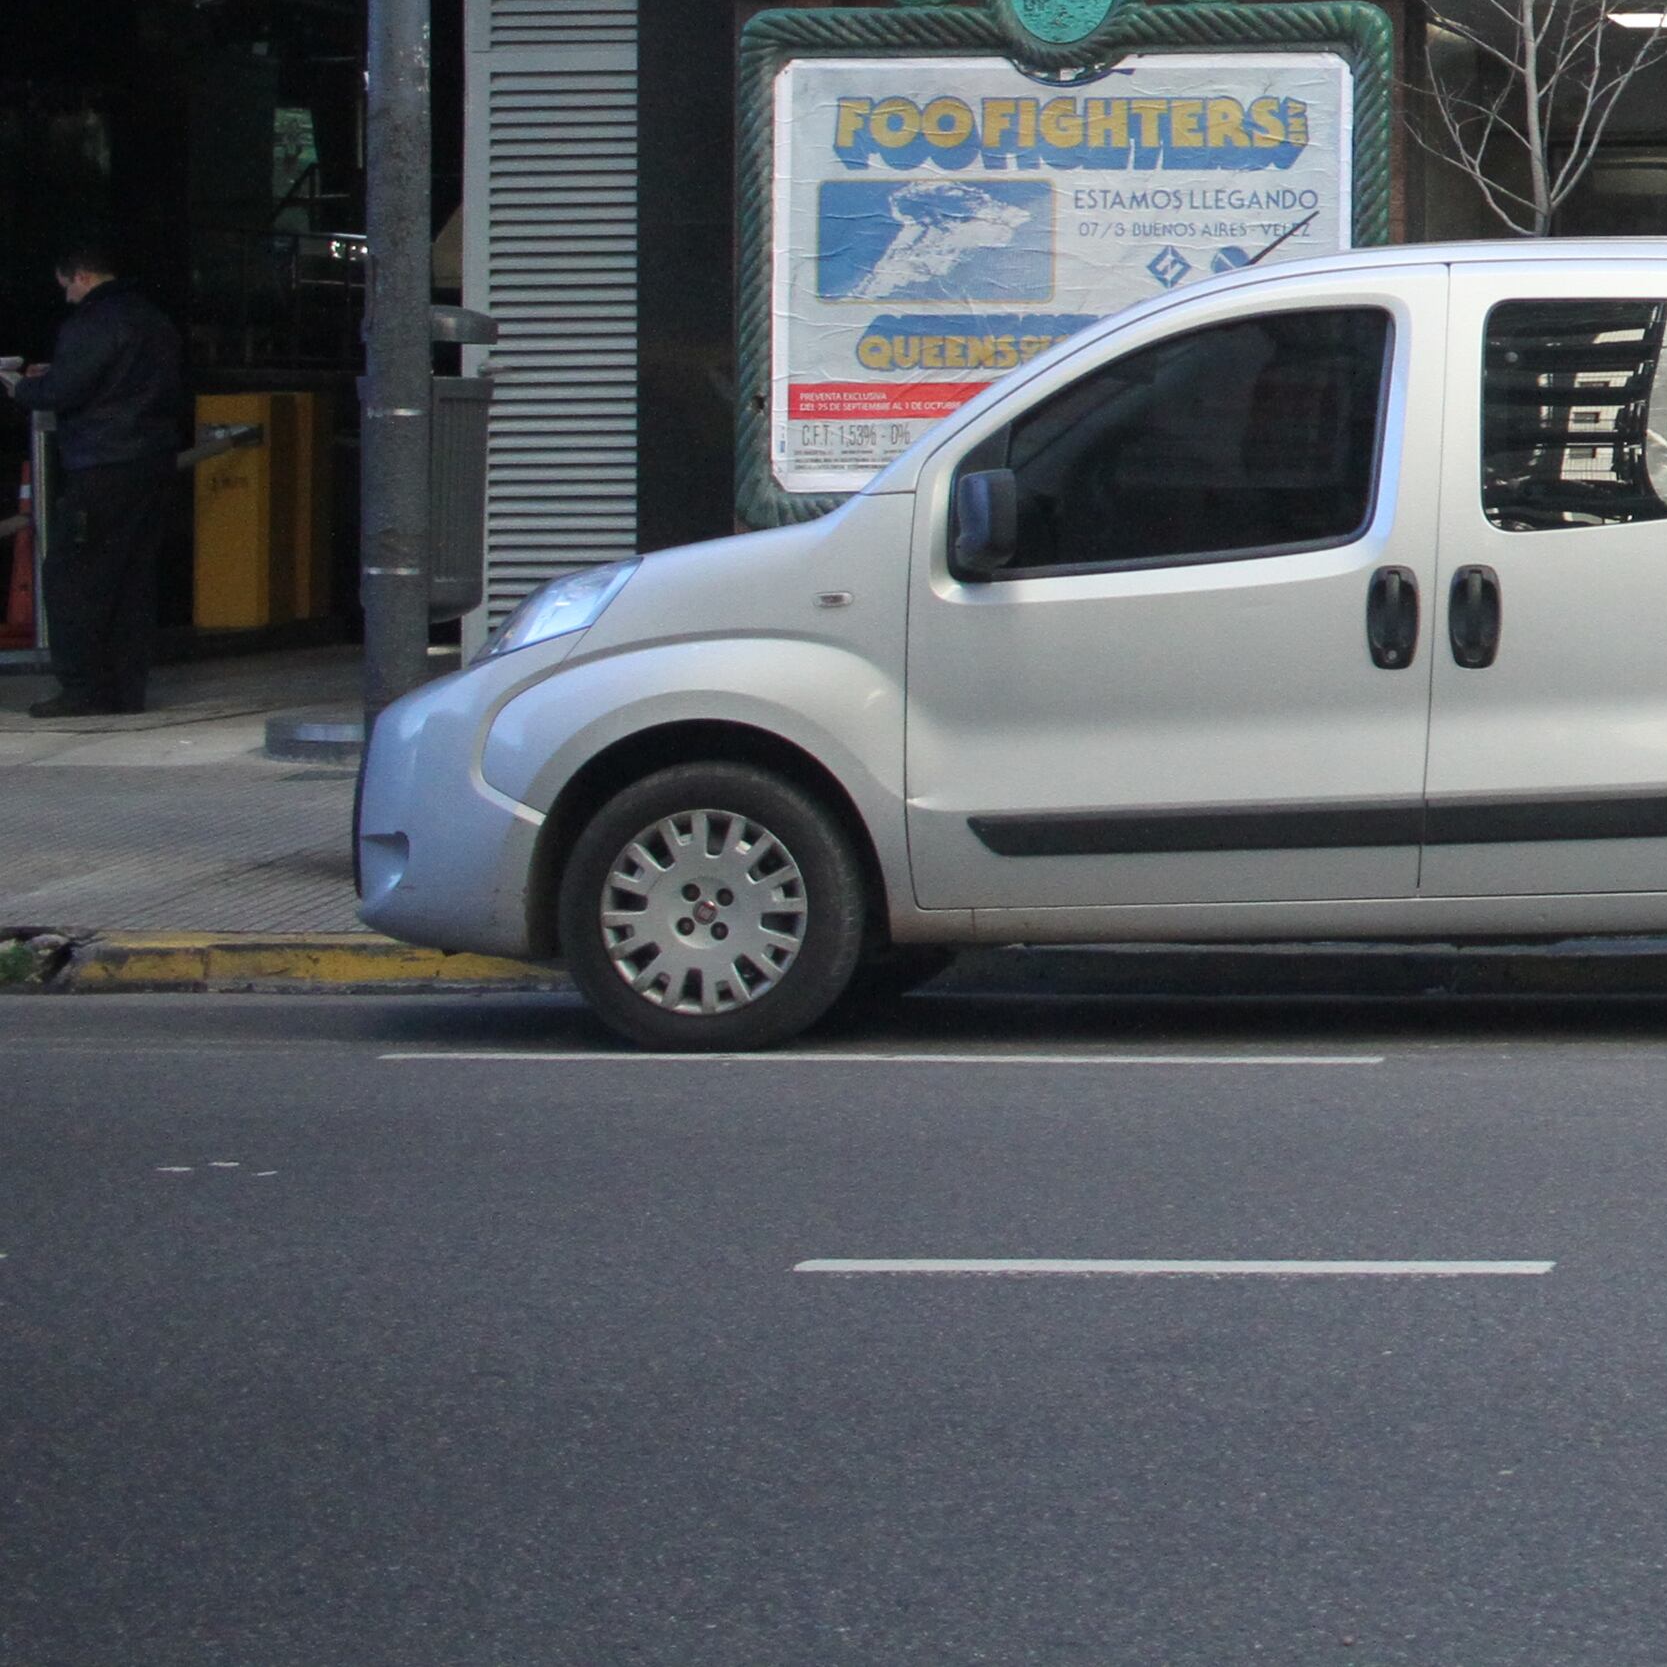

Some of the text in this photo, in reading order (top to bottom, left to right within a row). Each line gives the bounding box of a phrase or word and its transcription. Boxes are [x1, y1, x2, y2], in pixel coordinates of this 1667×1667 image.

[836, 97, 977, 154] FOO
[982, 97, 1285, 154] FIGHTERS
[1074, 189, 1319, 210] ESTAMOS LLEGANDO
[1132, 222, 1196, 237] BUENOS
[1201, 221, 1247, 237] AIRES
[856, 334, 1021, 371] QUEENS
